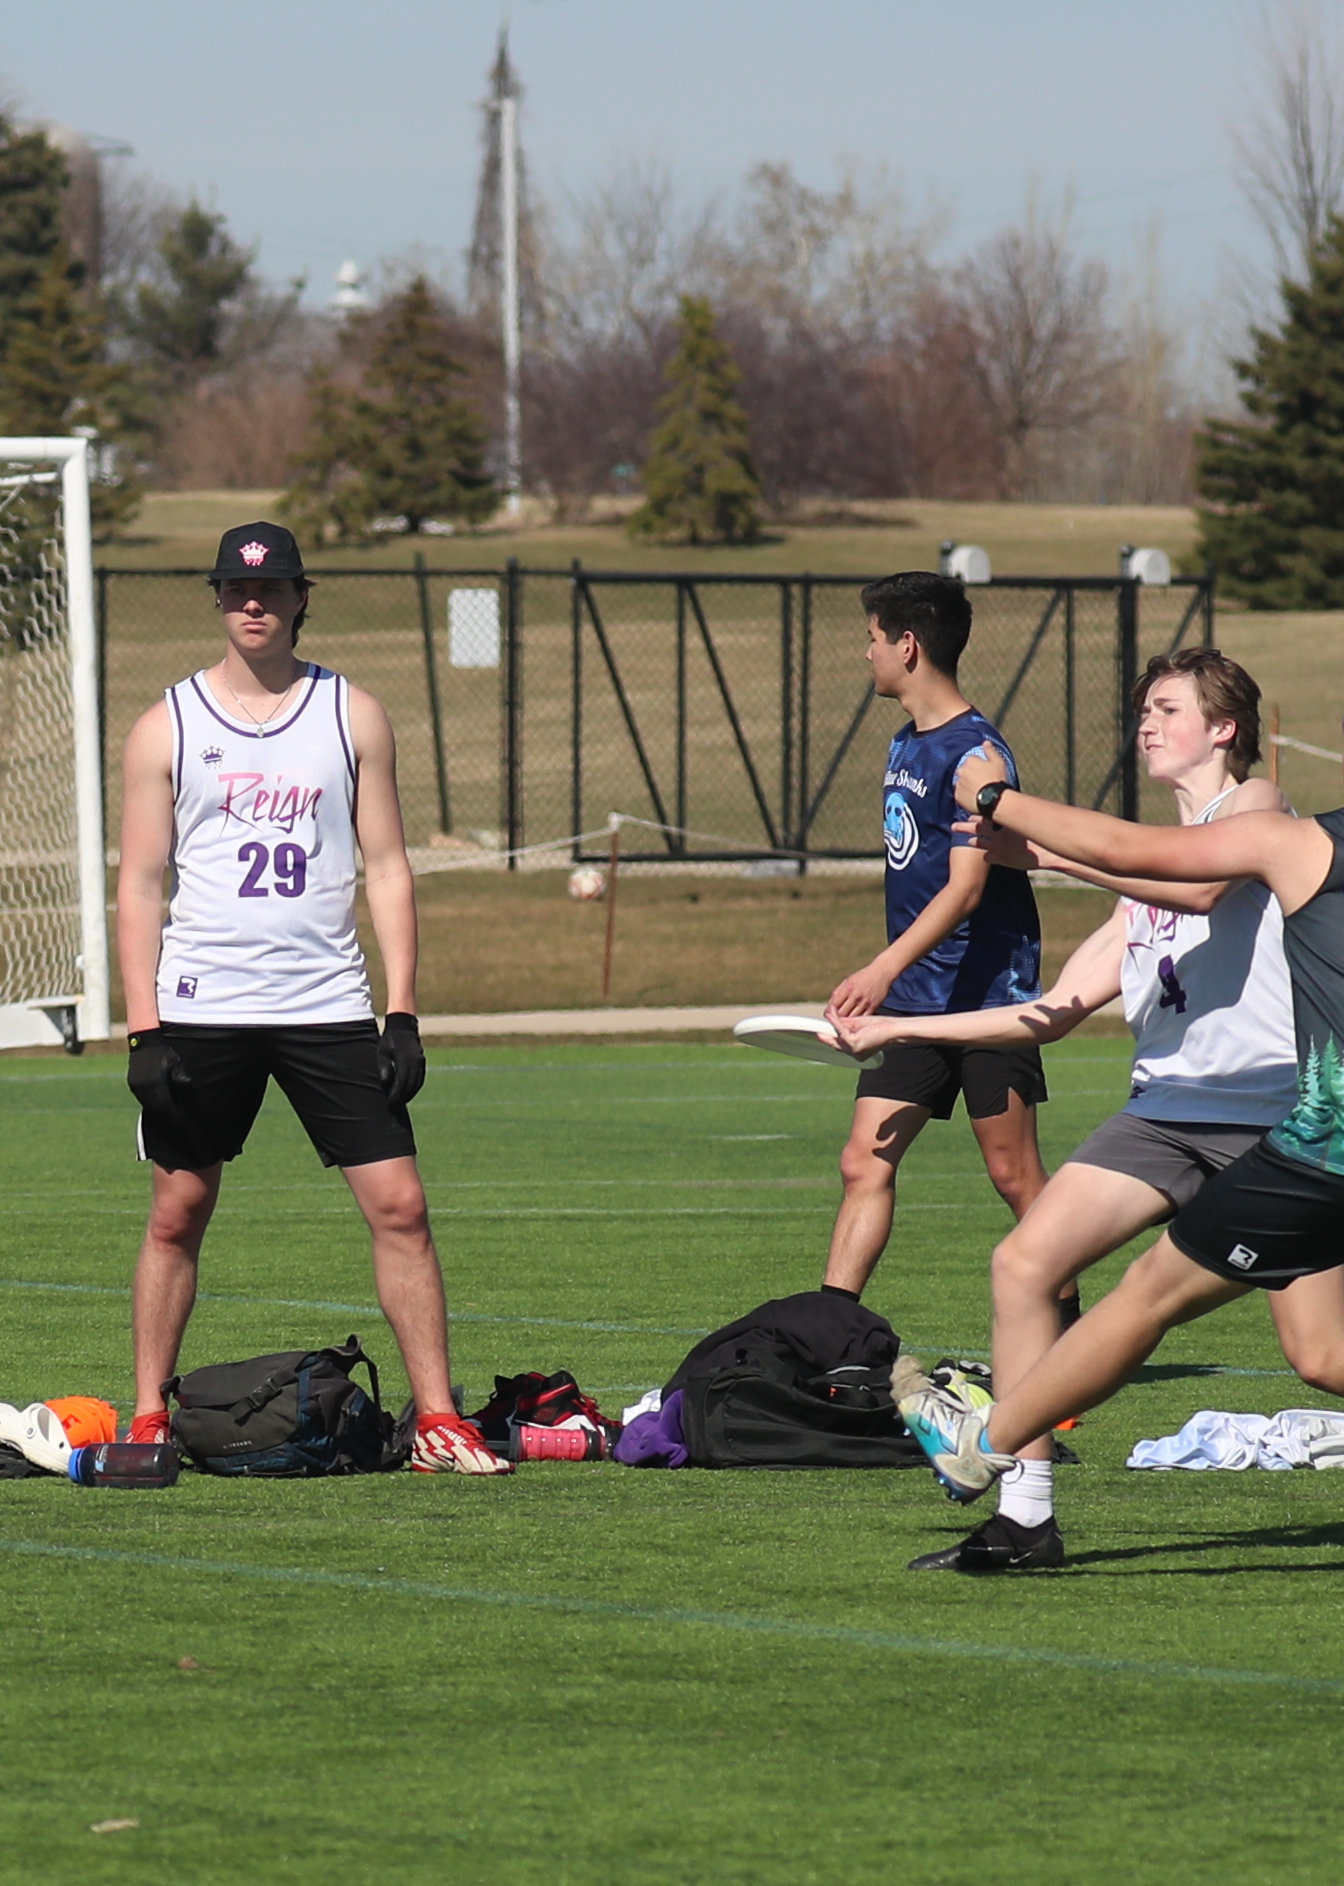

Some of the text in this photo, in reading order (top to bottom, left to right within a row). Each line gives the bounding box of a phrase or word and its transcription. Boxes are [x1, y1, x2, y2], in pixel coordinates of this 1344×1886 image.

[216, 772, 323, 837] Reign
[237, 841, 307, 898] 29
[1157, 954, 1188, 1015] 4
